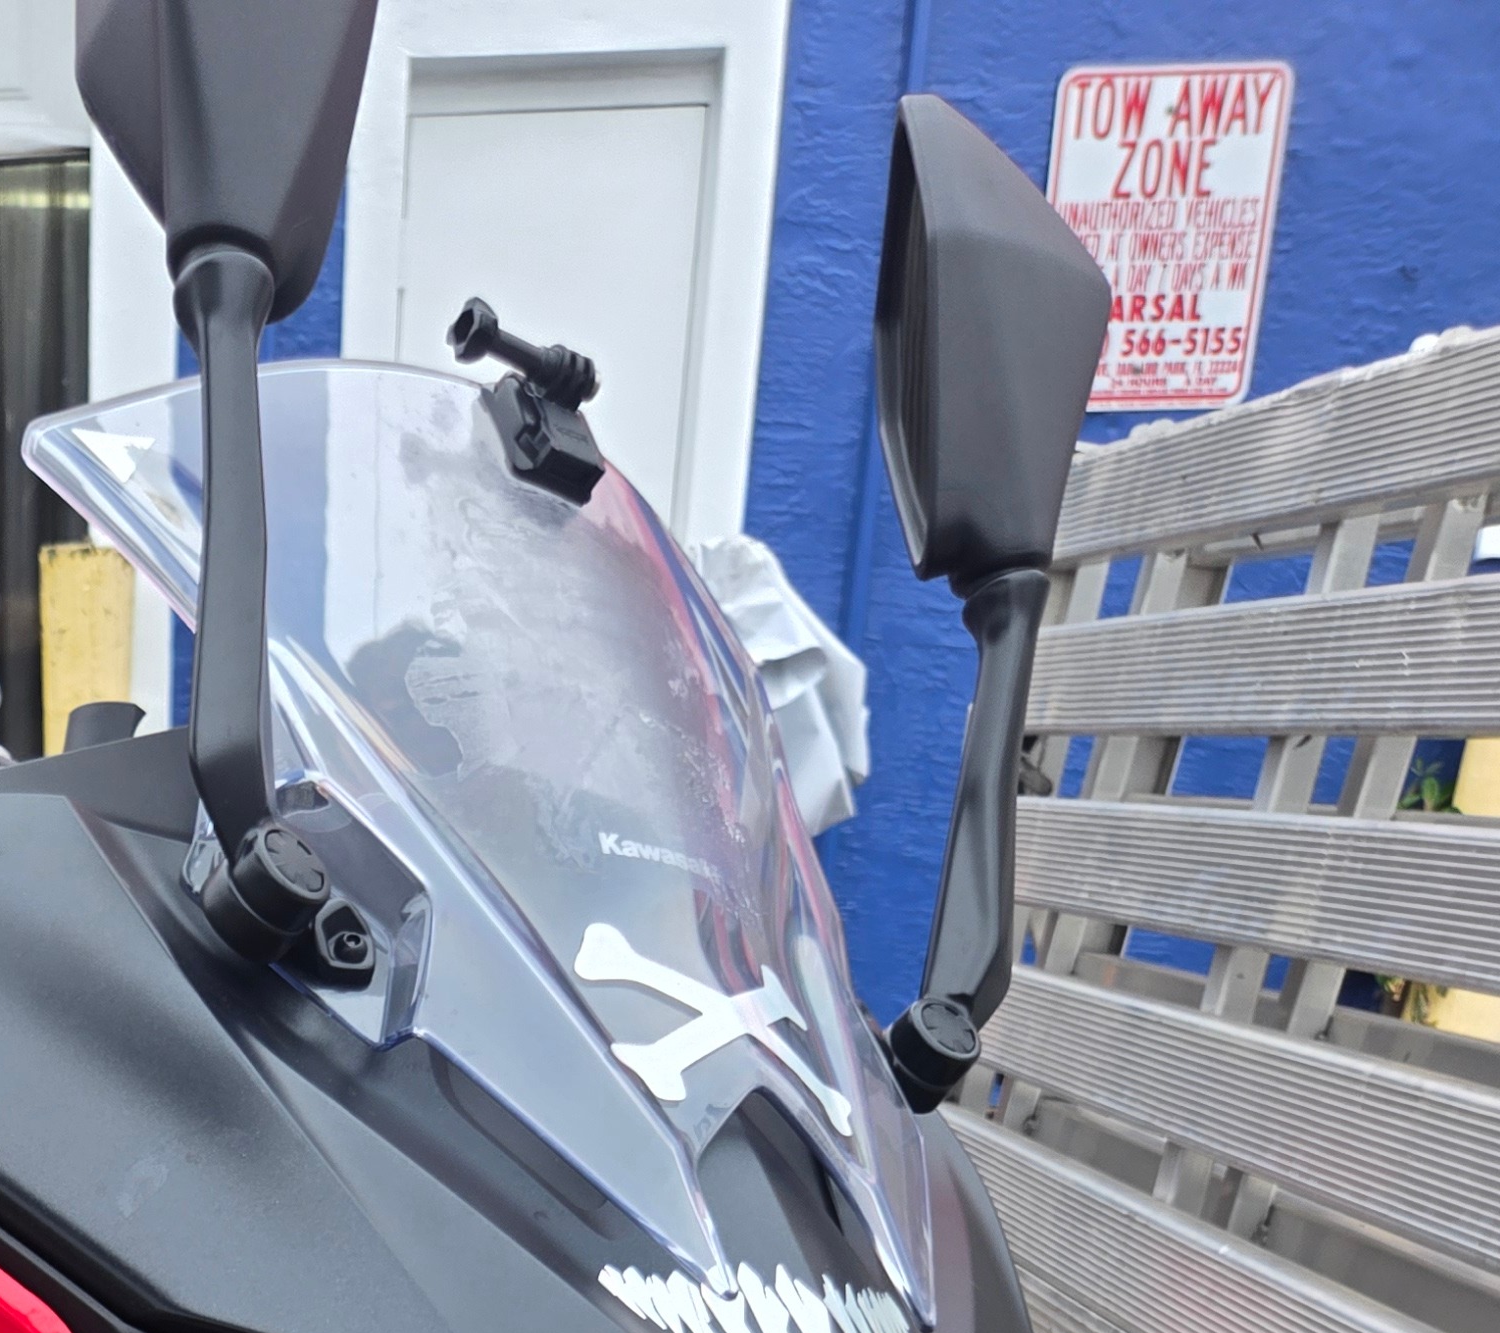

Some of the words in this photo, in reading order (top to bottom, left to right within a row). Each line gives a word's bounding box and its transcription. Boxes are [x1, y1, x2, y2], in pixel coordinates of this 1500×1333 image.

[1069, 77, 1149, 141] TOW
[1167, 73, 1278, 137] AWAY
[1111, 138, 1217, 199] ZONE
[1185, 198, 1261, 229] VEHICLES
[1128, 231, 1188, 262] OWNERS
[1192, 229, 1258, 261] EXPENSE
[1126, 262, 1152, 293] DAY
[1170, 262, 1206, 292] DAYS
[1120, 326, 1243, 357] 566-5155
